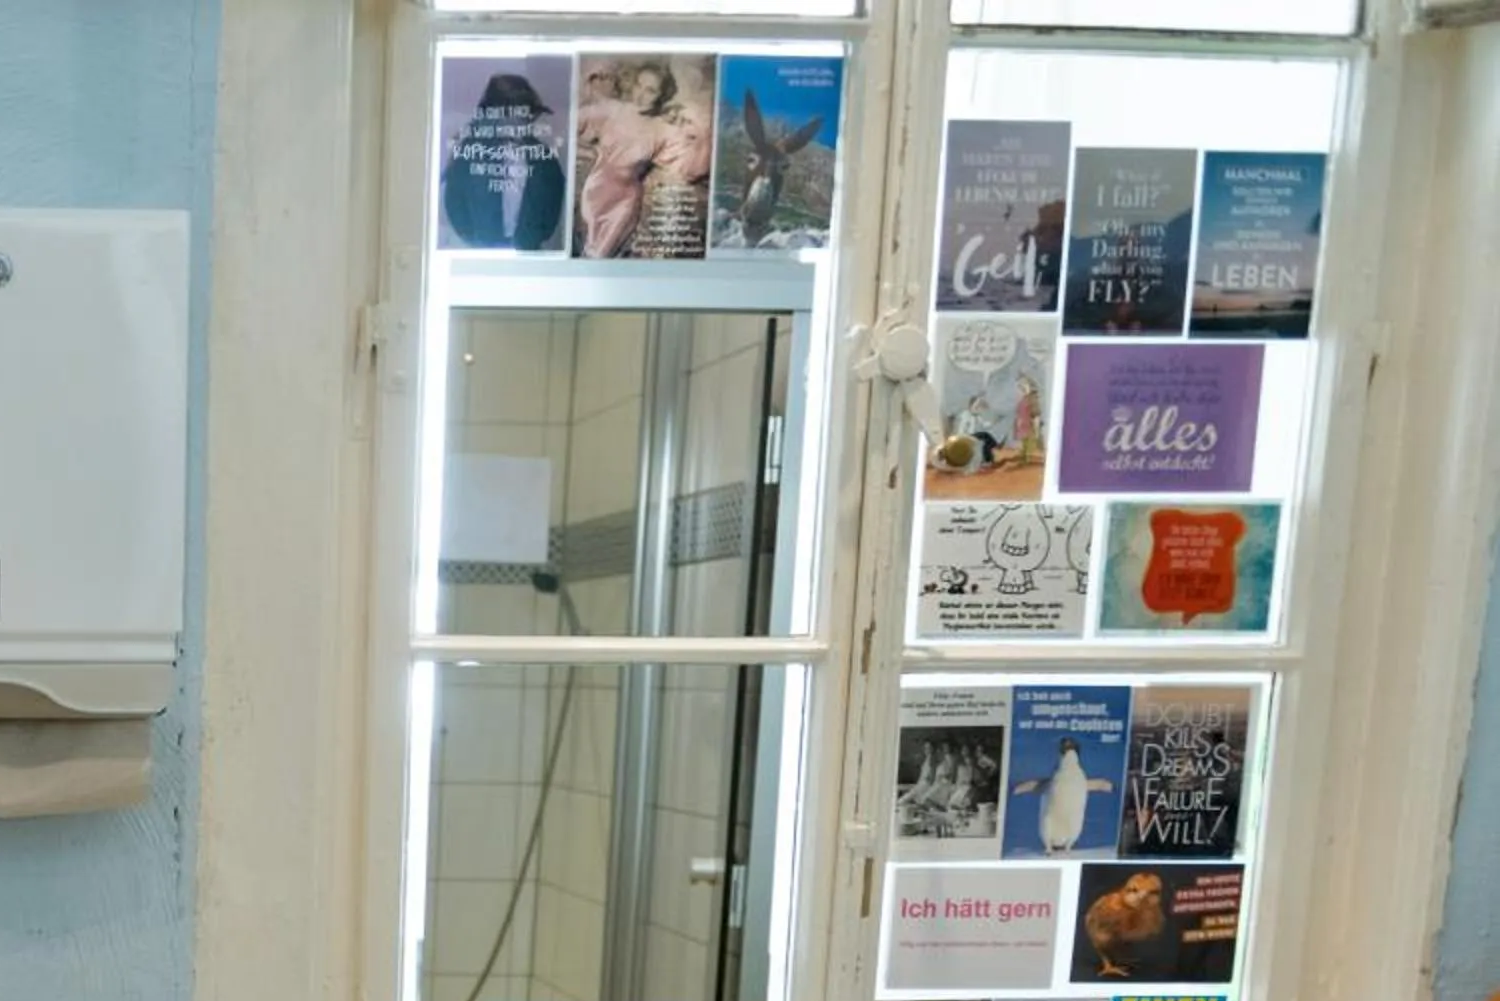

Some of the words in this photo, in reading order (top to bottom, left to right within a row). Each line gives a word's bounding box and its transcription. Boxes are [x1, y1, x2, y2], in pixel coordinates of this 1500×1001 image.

[1212, 263, 1299, 289] LEBEN
[1103, 405, 1218, 452] alles
[1145, 702, 1236, 741] DOUBT
[1164, 726, 1211, 757] KILLS
[1141, 743, 1231, 777] DREAMS
[1144, 777, 1227, 811] FAILURE
[900, 898, 937, 918] Ich
[945, 898, 990, 918] hätt
[998, 902, 1052, 922] gern
